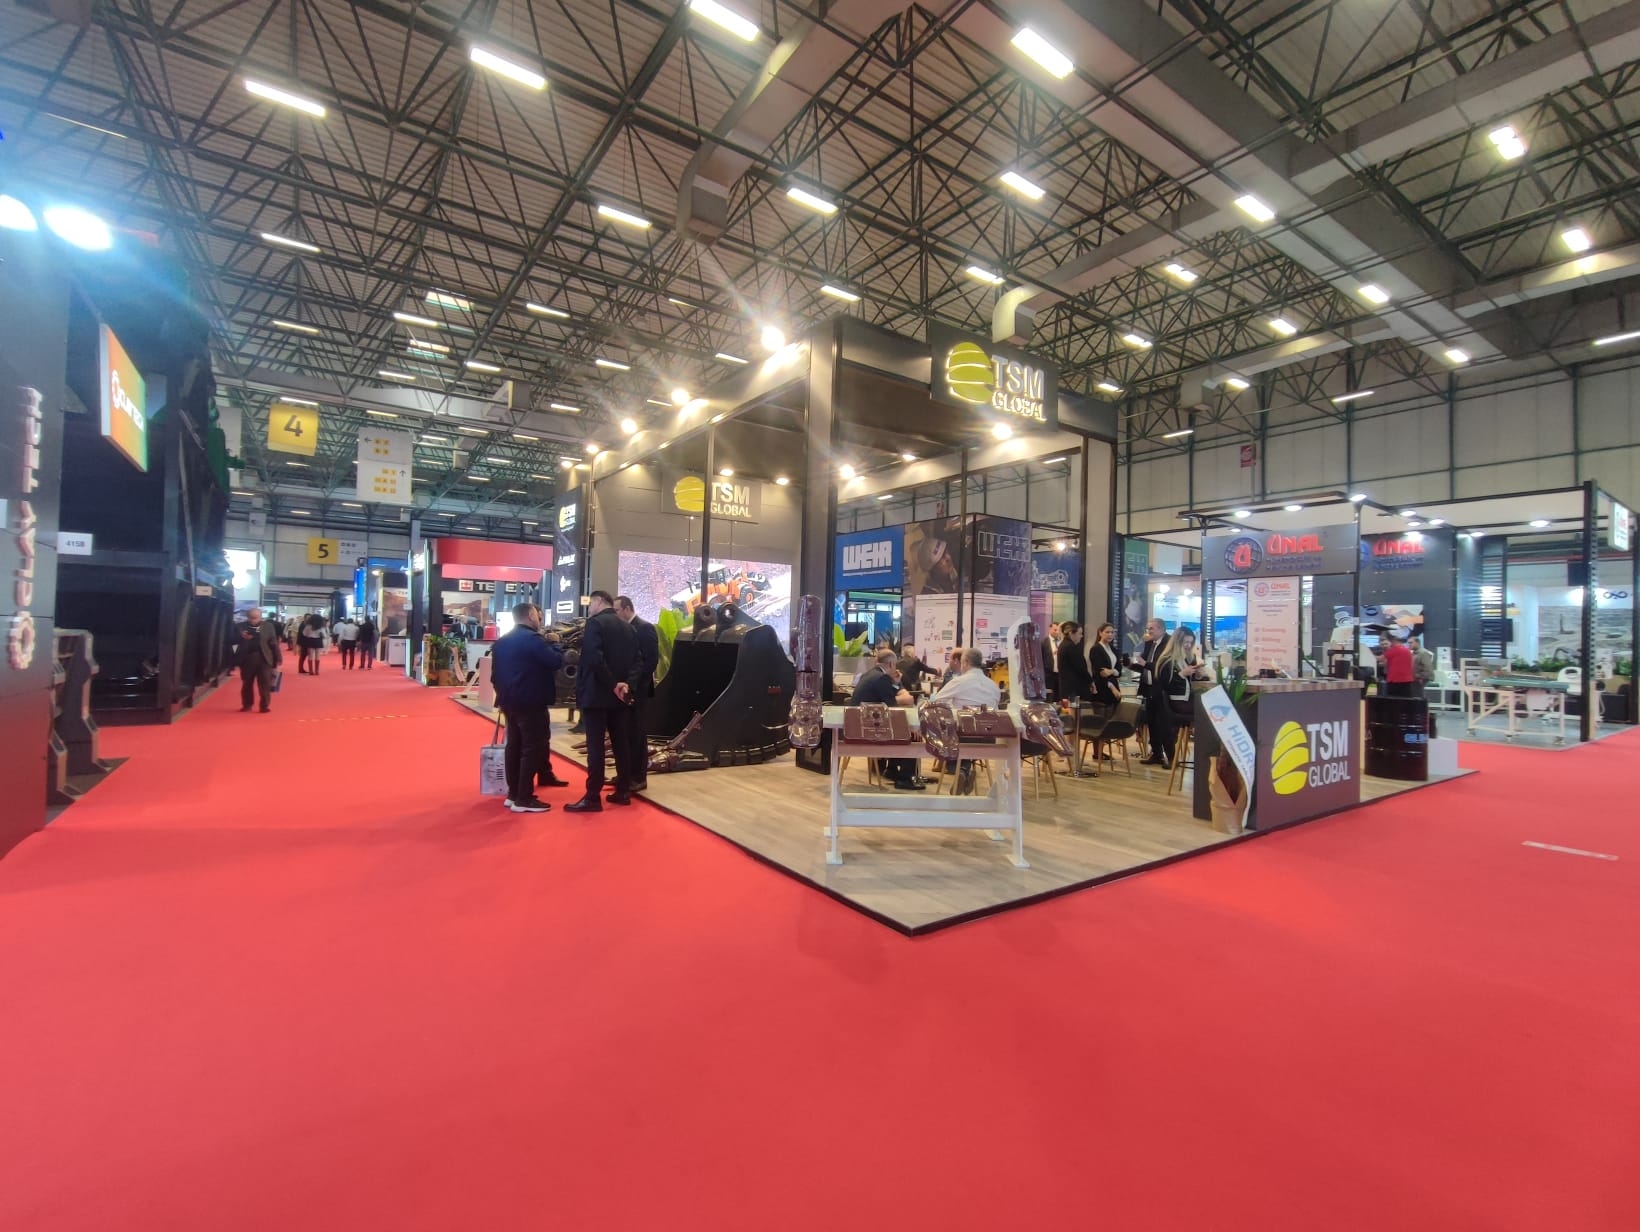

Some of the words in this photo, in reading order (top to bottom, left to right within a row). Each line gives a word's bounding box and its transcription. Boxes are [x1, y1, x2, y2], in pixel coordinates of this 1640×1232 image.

[991, 354, 1045, 401] TSM
[992, 391, 1047, 422] GLOBAL
[284, 414, 303, 438] 4
[711, 482, 750, 505] TSM
[711, 503, 752, 517] GLOBAL
[317, 543, 329, 559] 5
[1307, 720, 1348, 763] TSM
[1308, 760, 1351, 788] GLOBAL
